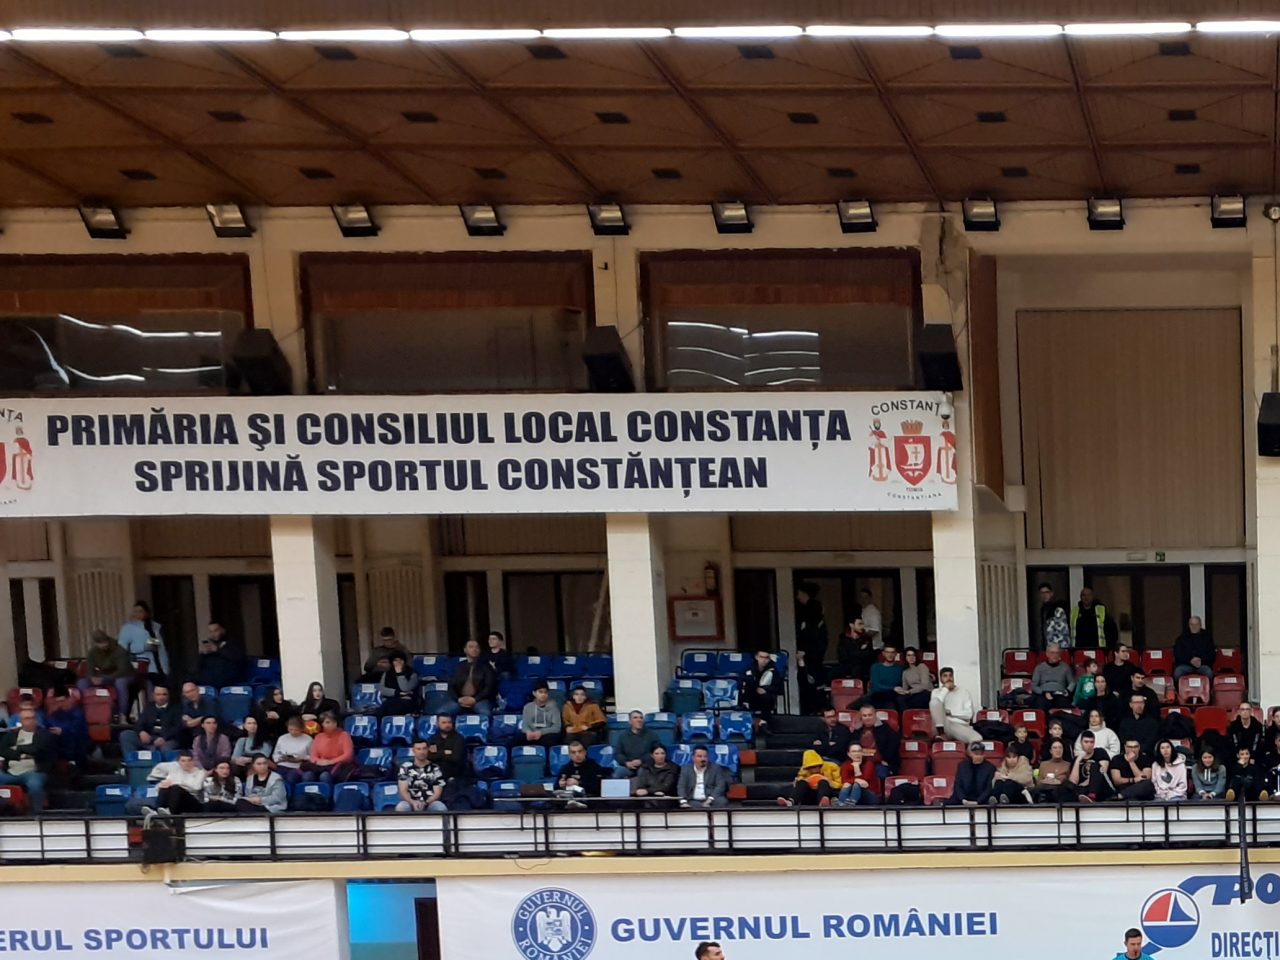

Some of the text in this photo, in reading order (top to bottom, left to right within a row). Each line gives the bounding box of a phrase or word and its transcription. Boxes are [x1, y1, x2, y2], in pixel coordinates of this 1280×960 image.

[47, 407, 239, 446] PRIMĂRIA
[296, 411, 495, 446] CONSILIUL
[504, 410, 617, 444] LOCAL
[134, 453, 308, 493] SPRIJINĂ
[317, 458, 489, 492] SPORTUL
[518, 891, 589, 920] GUVERNUL
[83, 927, 269, 950] SPORTULUI
[610, 907, 999, 943] GUVERNUL ROMÂNIEI
